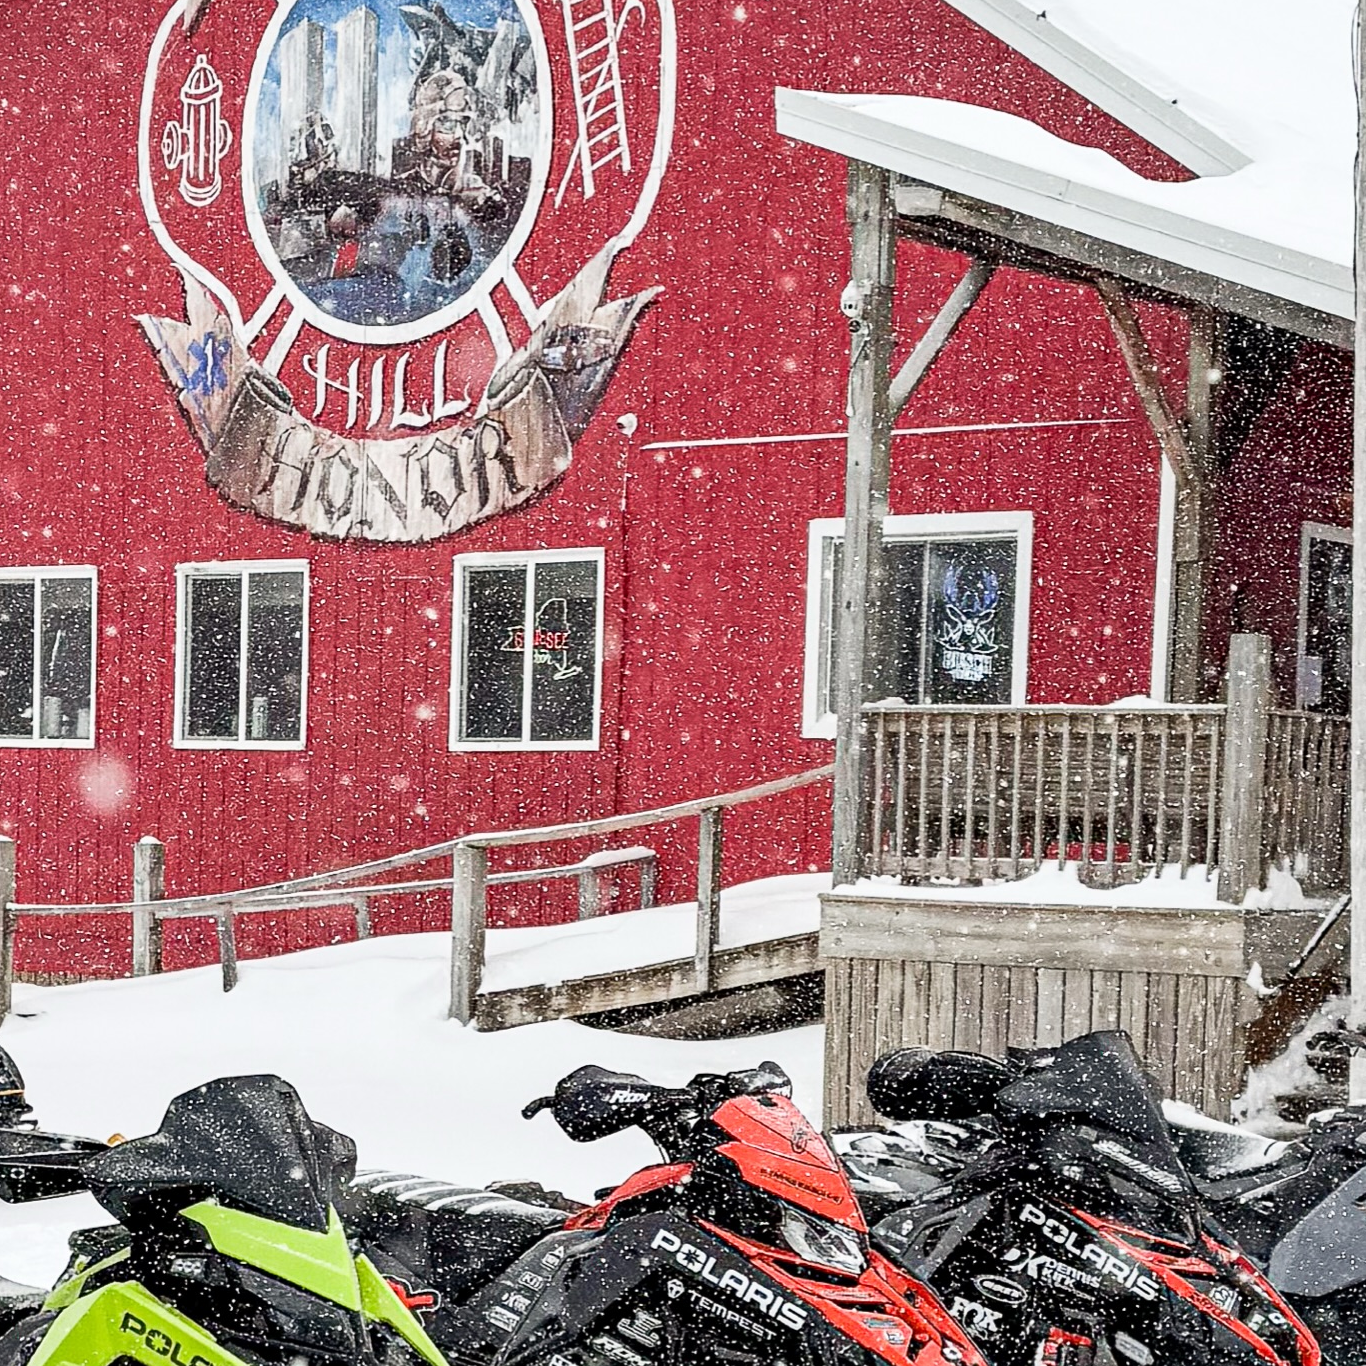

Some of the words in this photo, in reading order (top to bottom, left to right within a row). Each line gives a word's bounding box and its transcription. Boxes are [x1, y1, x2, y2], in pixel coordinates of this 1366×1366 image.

[303, 338, 473, 430] HILL
[258, 420, 529, 531] HONOR
[650, 1229, 809, 1331] POLARIS
[1019, 1203, 1160, 1302] POLARIS
[687, 1289, 777, 1340] TEMPEST
[951, 1295, 1004, 1332] FOX
